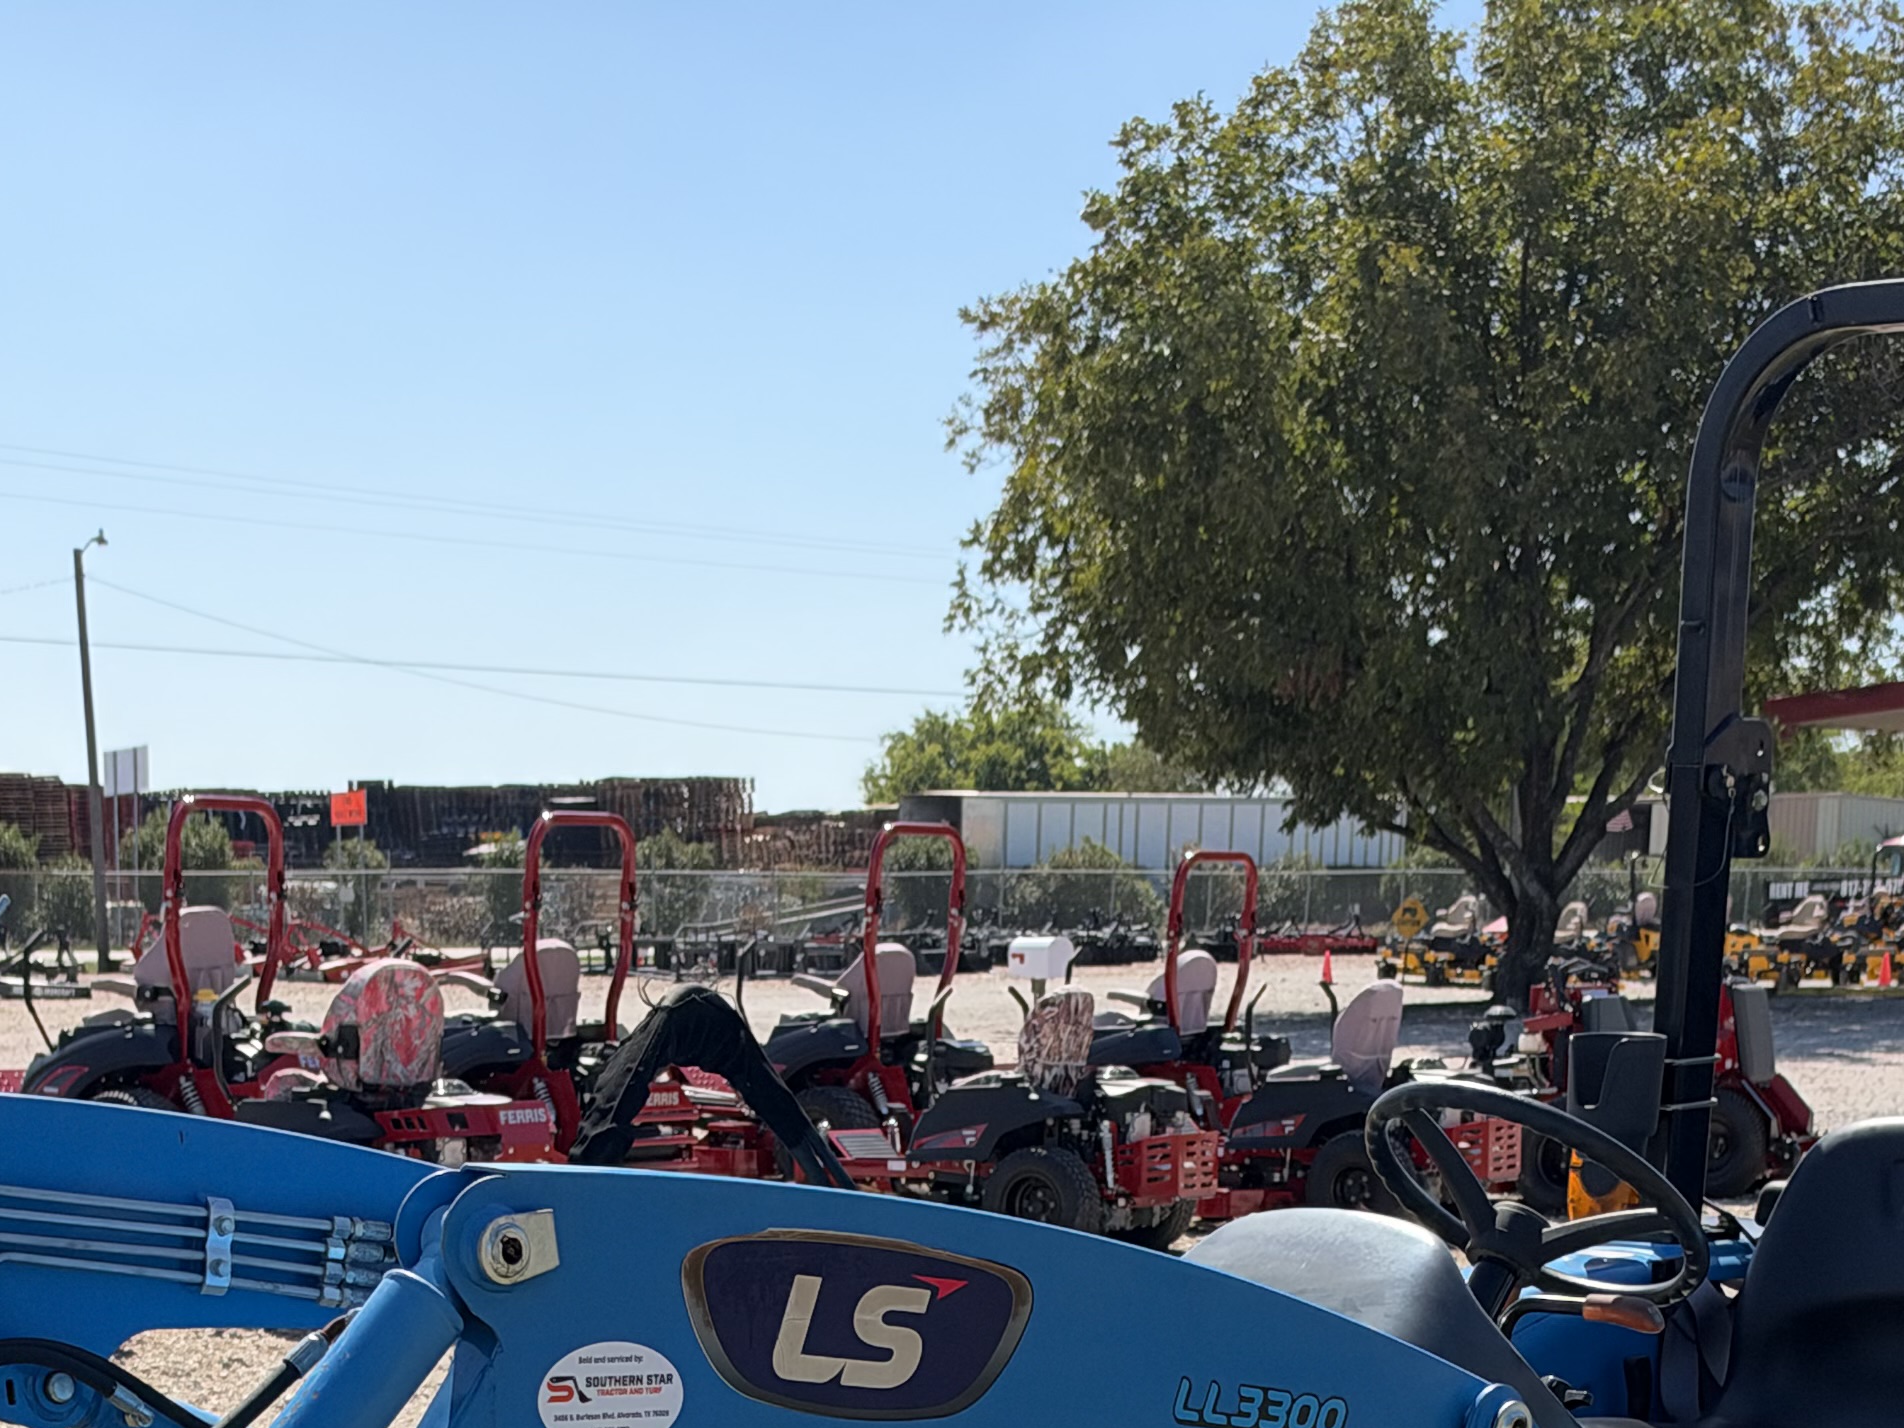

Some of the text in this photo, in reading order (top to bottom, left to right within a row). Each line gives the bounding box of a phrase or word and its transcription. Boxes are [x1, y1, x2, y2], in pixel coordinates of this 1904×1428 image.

[646, 1091, 679, 1106] ERRIS
[499, 1108, 547, 1125] FERRIS
[772, 1274, 932, 1389] LS
[594, 1355, 606, 1364] and
[607, 1355, 633, 1364] serviced
[585, 1373, 674, 1388] SOUTHERN STAR
[597, 1386, 663, 1397] TRACTOR AND TURF
